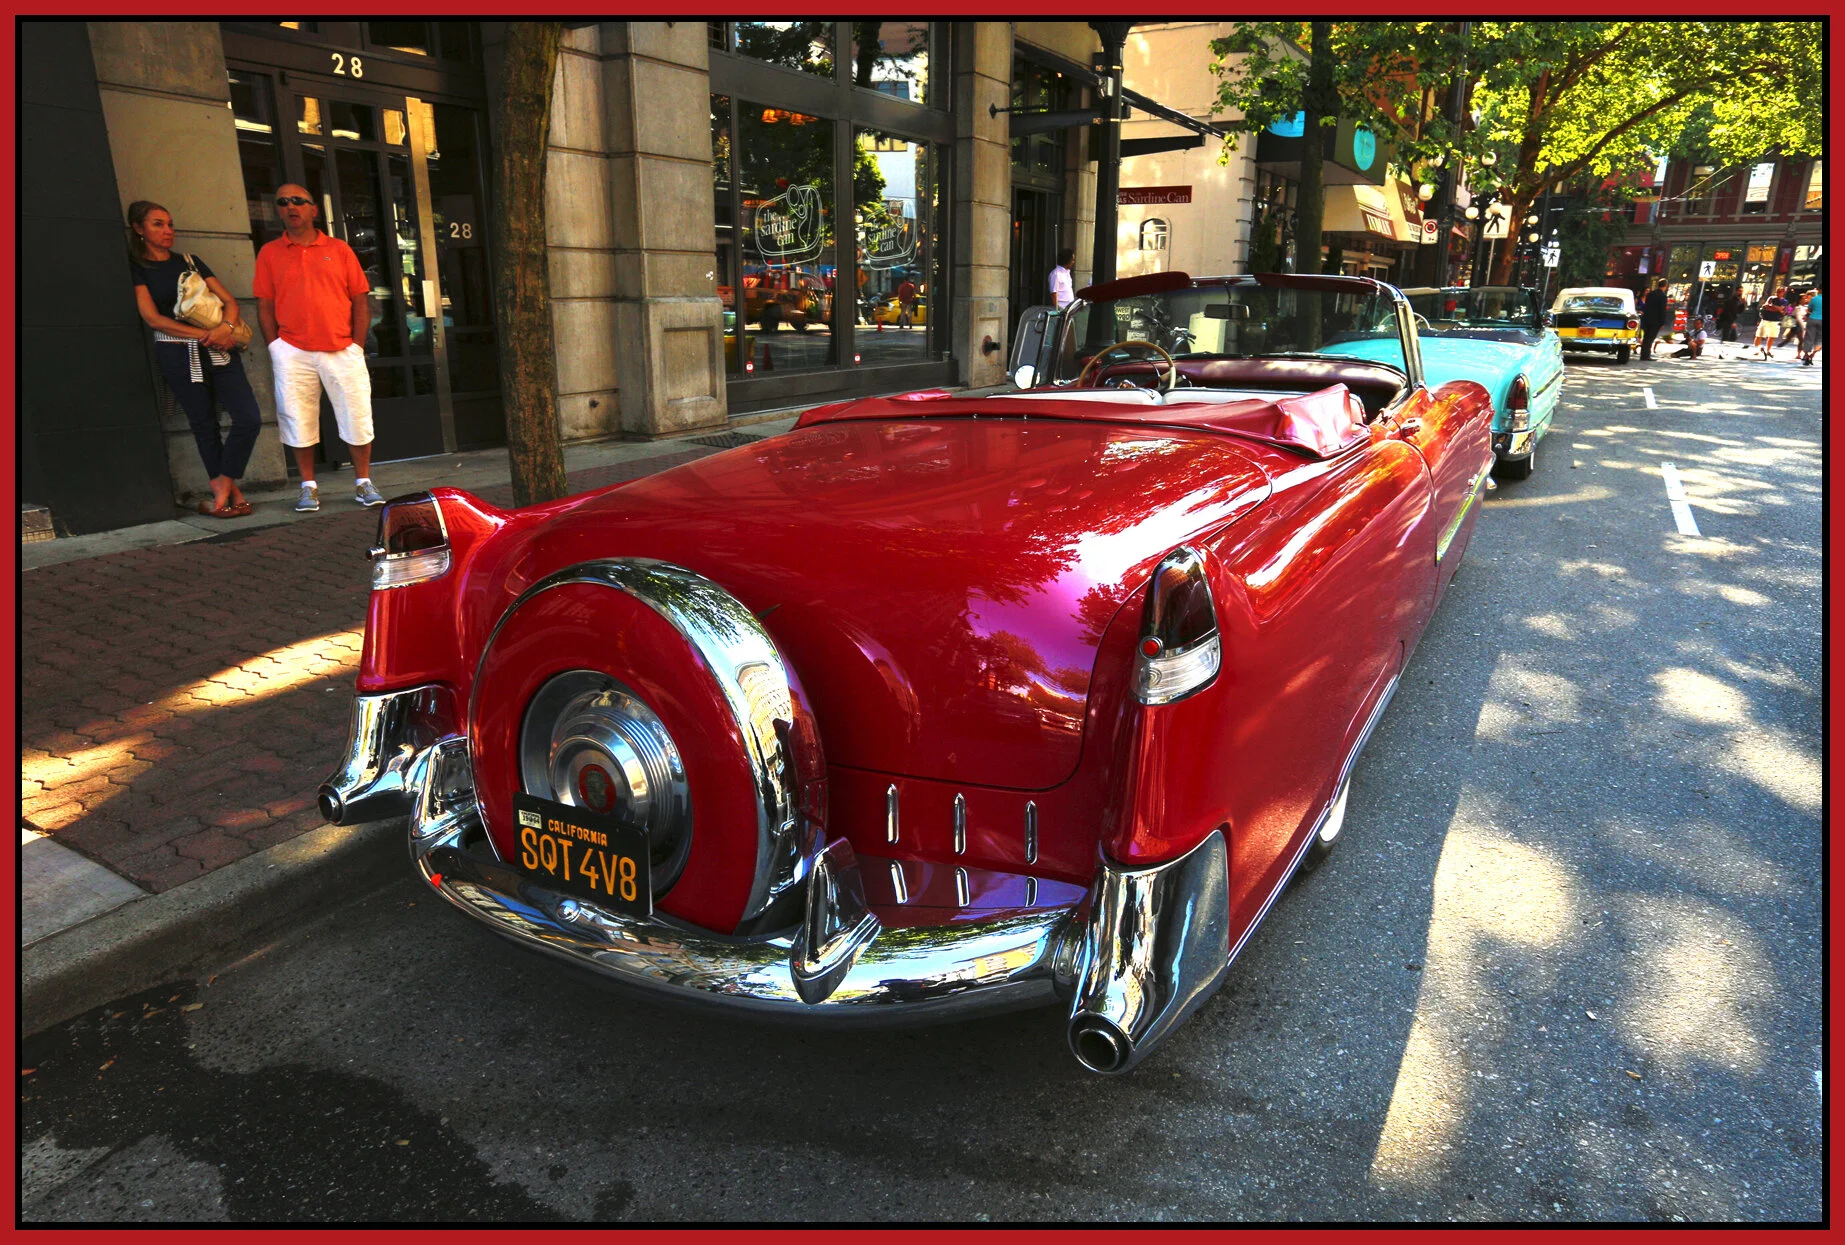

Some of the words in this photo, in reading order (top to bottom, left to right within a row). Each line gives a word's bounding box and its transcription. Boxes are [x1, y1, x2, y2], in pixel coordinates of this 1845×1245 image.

[331, 52, 363, 78] 28
[1128, 191, 1166, 204] Sardine
[1167, 191, 1189, 203] Can
[763, 209, 777, 223] the
[450, 222, 472, 239] 28
[761, 215, 797, 237] sardine
[777, 232, 795, 247] can
[880, 240, 894, 252] can
[548, 819, 608, 847] CALIFORNIA
[521, 827, 573, 881] SQT
[580, 848, 637, 902] 4V8
